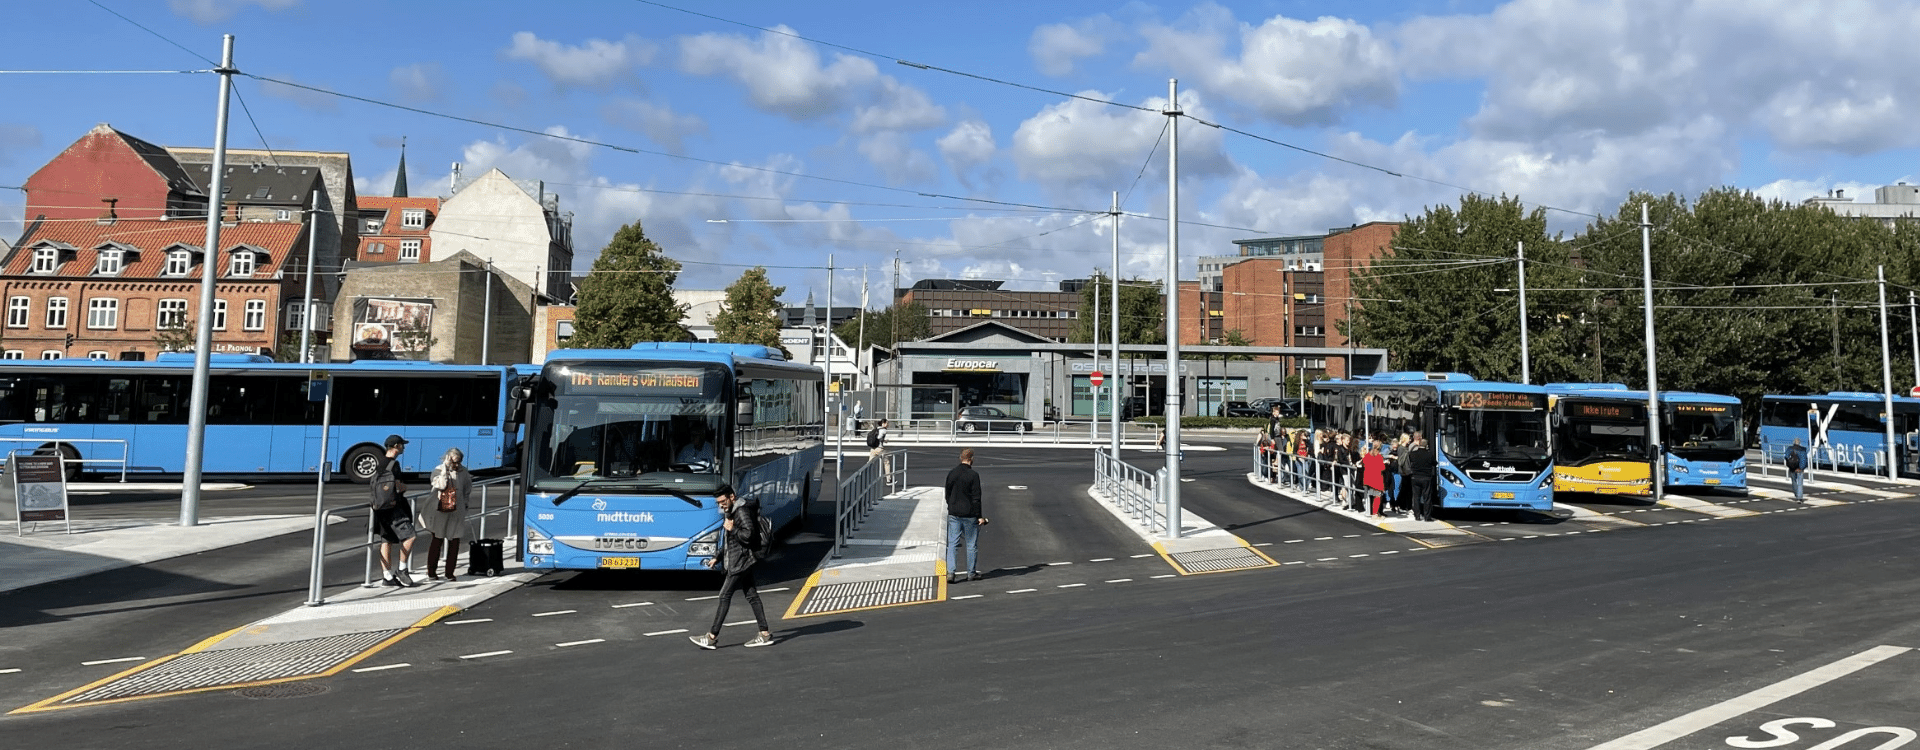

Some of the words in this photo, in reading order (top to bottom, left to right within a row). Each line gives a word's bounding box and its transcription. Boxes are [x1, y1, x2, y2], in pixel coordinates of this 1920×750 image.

[946, 358, 998, 370] Europcar
[597, 373, 639, 387] Randers
[658, 374, 699, 388] Hadsten
[1460, 392, 1483, 408] 123
[1583, 405, 1600, 415] Ikke
[1837, 443, 1865, 464] BUS
[597, 511, 654, 523] midttrafik
[594, 537, 649, 550] IVECO
[602, 558, 613, 567] DB
